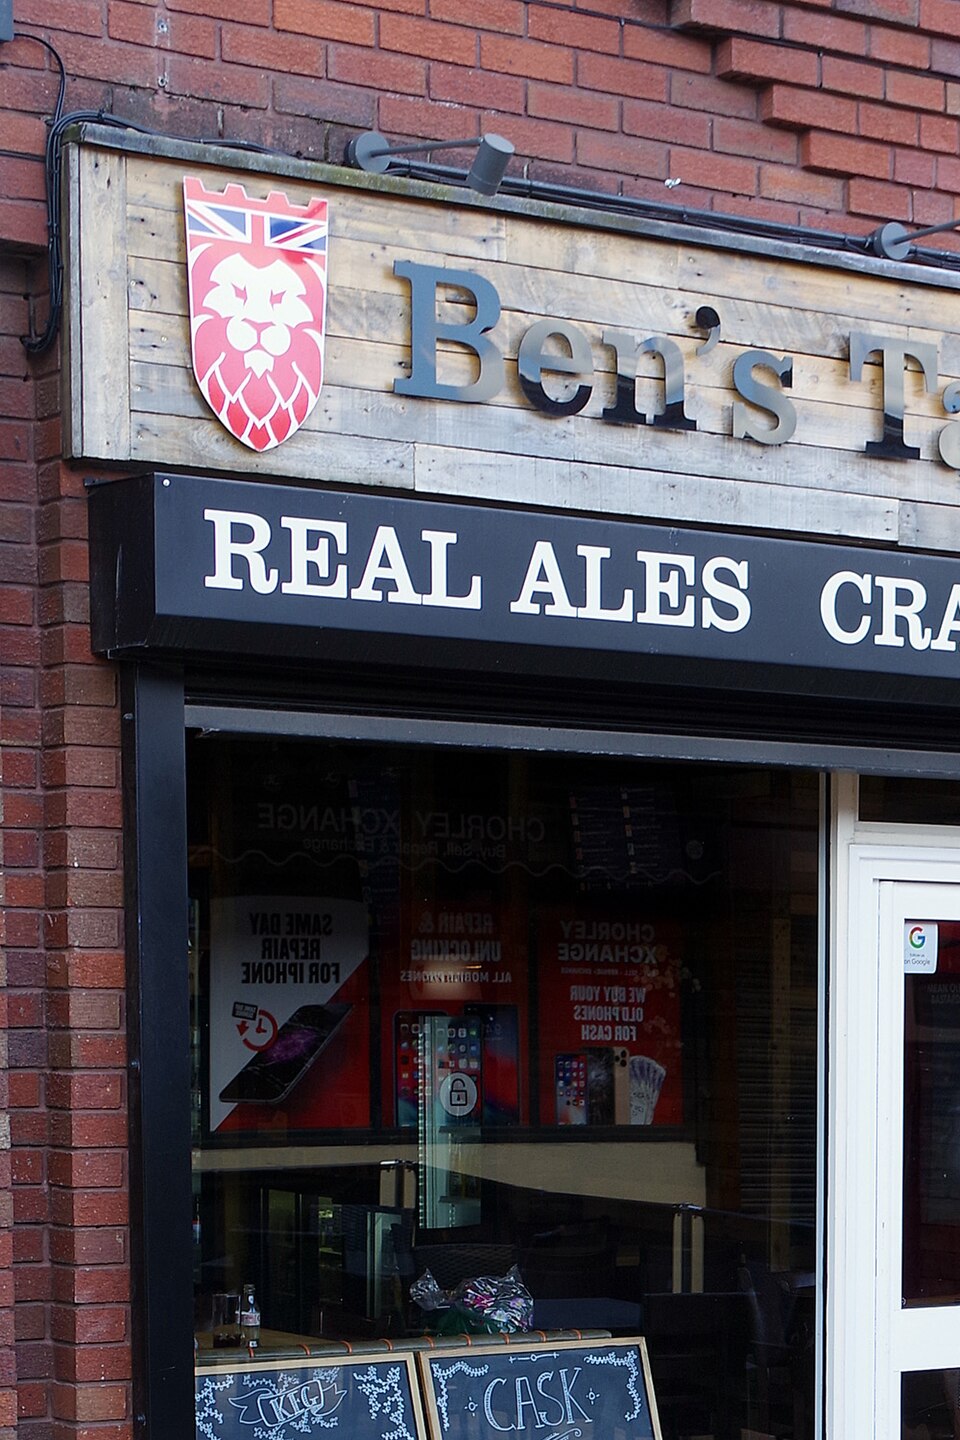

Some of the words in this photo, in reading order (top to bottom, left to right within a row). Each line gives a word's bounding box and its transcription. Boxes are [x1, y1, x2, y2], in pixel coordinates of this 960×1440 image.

[393, 260, 797, 445] Ben's
[204, 509, 481, 610] REAL
[510, 539, 751, 633] ALES
[909, 926, 926, 949] G
[912, 958, 930, 966] Google
[483, 1367, 592, 1432] CASK
